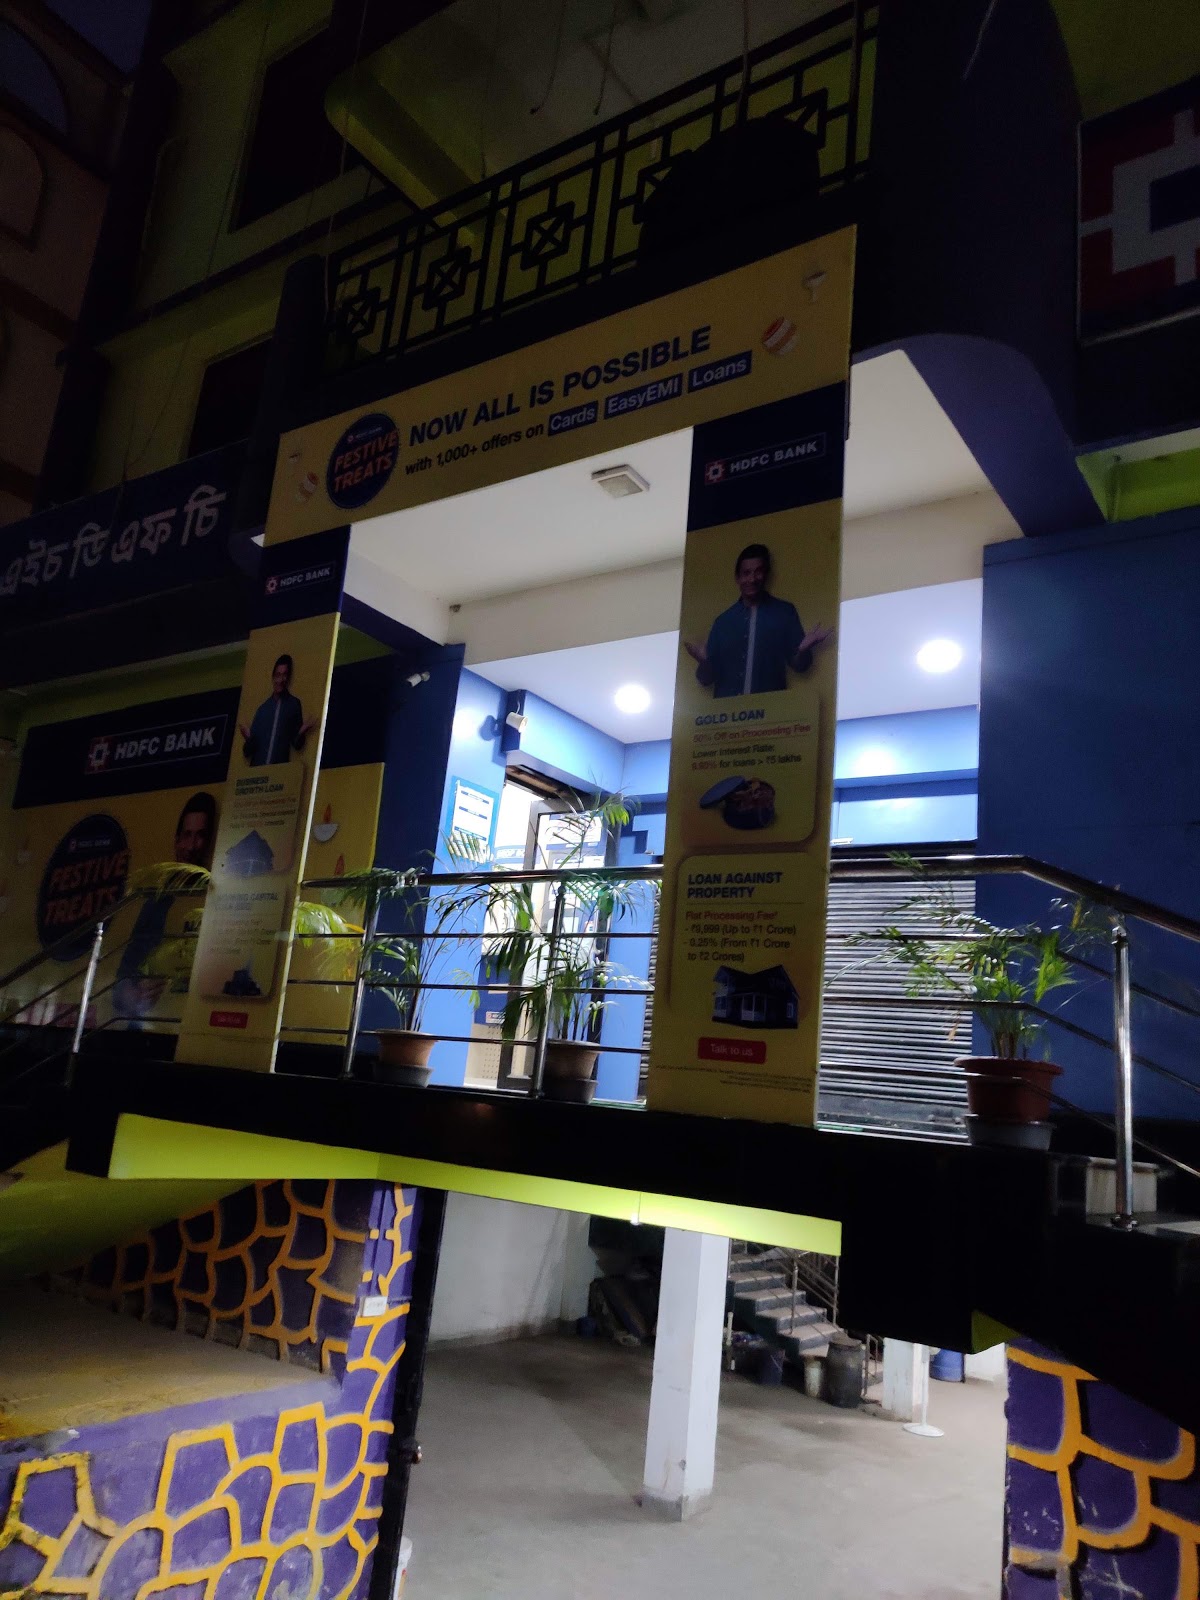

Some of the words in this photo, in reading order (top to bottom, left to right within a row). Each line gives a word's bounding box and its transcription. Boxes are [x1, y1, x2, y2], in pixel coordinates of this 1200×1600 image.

[409, 409, 467, 446] NOW
[473, 393, 520, 426] ALL
[529, 380, 554, 408] IS
[563, 326, 711, 397] POSSIBLE
[405, 456, 432, 475] with
[436, 443, 477, 467] 1,000+
[481, 430, 522, 452] offers
[525, 423, 544, 439] on
[550, 406, 595, 431] Cards
[606, 377, 680, 414] EasyEMI
[692, 358, 747, 387] Loans
[334, 431, 399, 474] FESTIVE
[729, 452, 770, 473] HDFC
[774, 440, 817, 462] BANK
[333, 452, 393, 494] TREATS
[280, 573, 304, 587] HDFC
[305, 567, 330, 581] BANK
[695, 713, 728, 726] GOLD
[732, 709, 765, 722] LOAN
[114, 736, 161, 761] HDFC
[163, 726, 216, 753] BANK
[693, 749, 718, 759] Lower
[719, 745, 751, 756] Interest
[719, 759, 731, 768] for
[733, 758, 756, 767] loans
[778, 753, 801, 763] lakhs
[687, 873, 722, 885] LOAN
[725, 871, 783, 884] AGAINST
[687, 886, 755, 899] PROPERTY
[704, 911, 754, 922] Processing
[721, 924, 738, 935] (Up
[741, 924, 751, 934] to
[766, 923, 797, 936] Crore)
[720, 937, 747, 948] (From
[763, 937, 791, 949] Crore
[687, 952, 697, 961] to
[712, 951, 744, 963] Crores)
[710, 1043, 728, 1054] Talk
[730, 1046, 740, 1055] to
[742, 1047, 754, 1057] us
